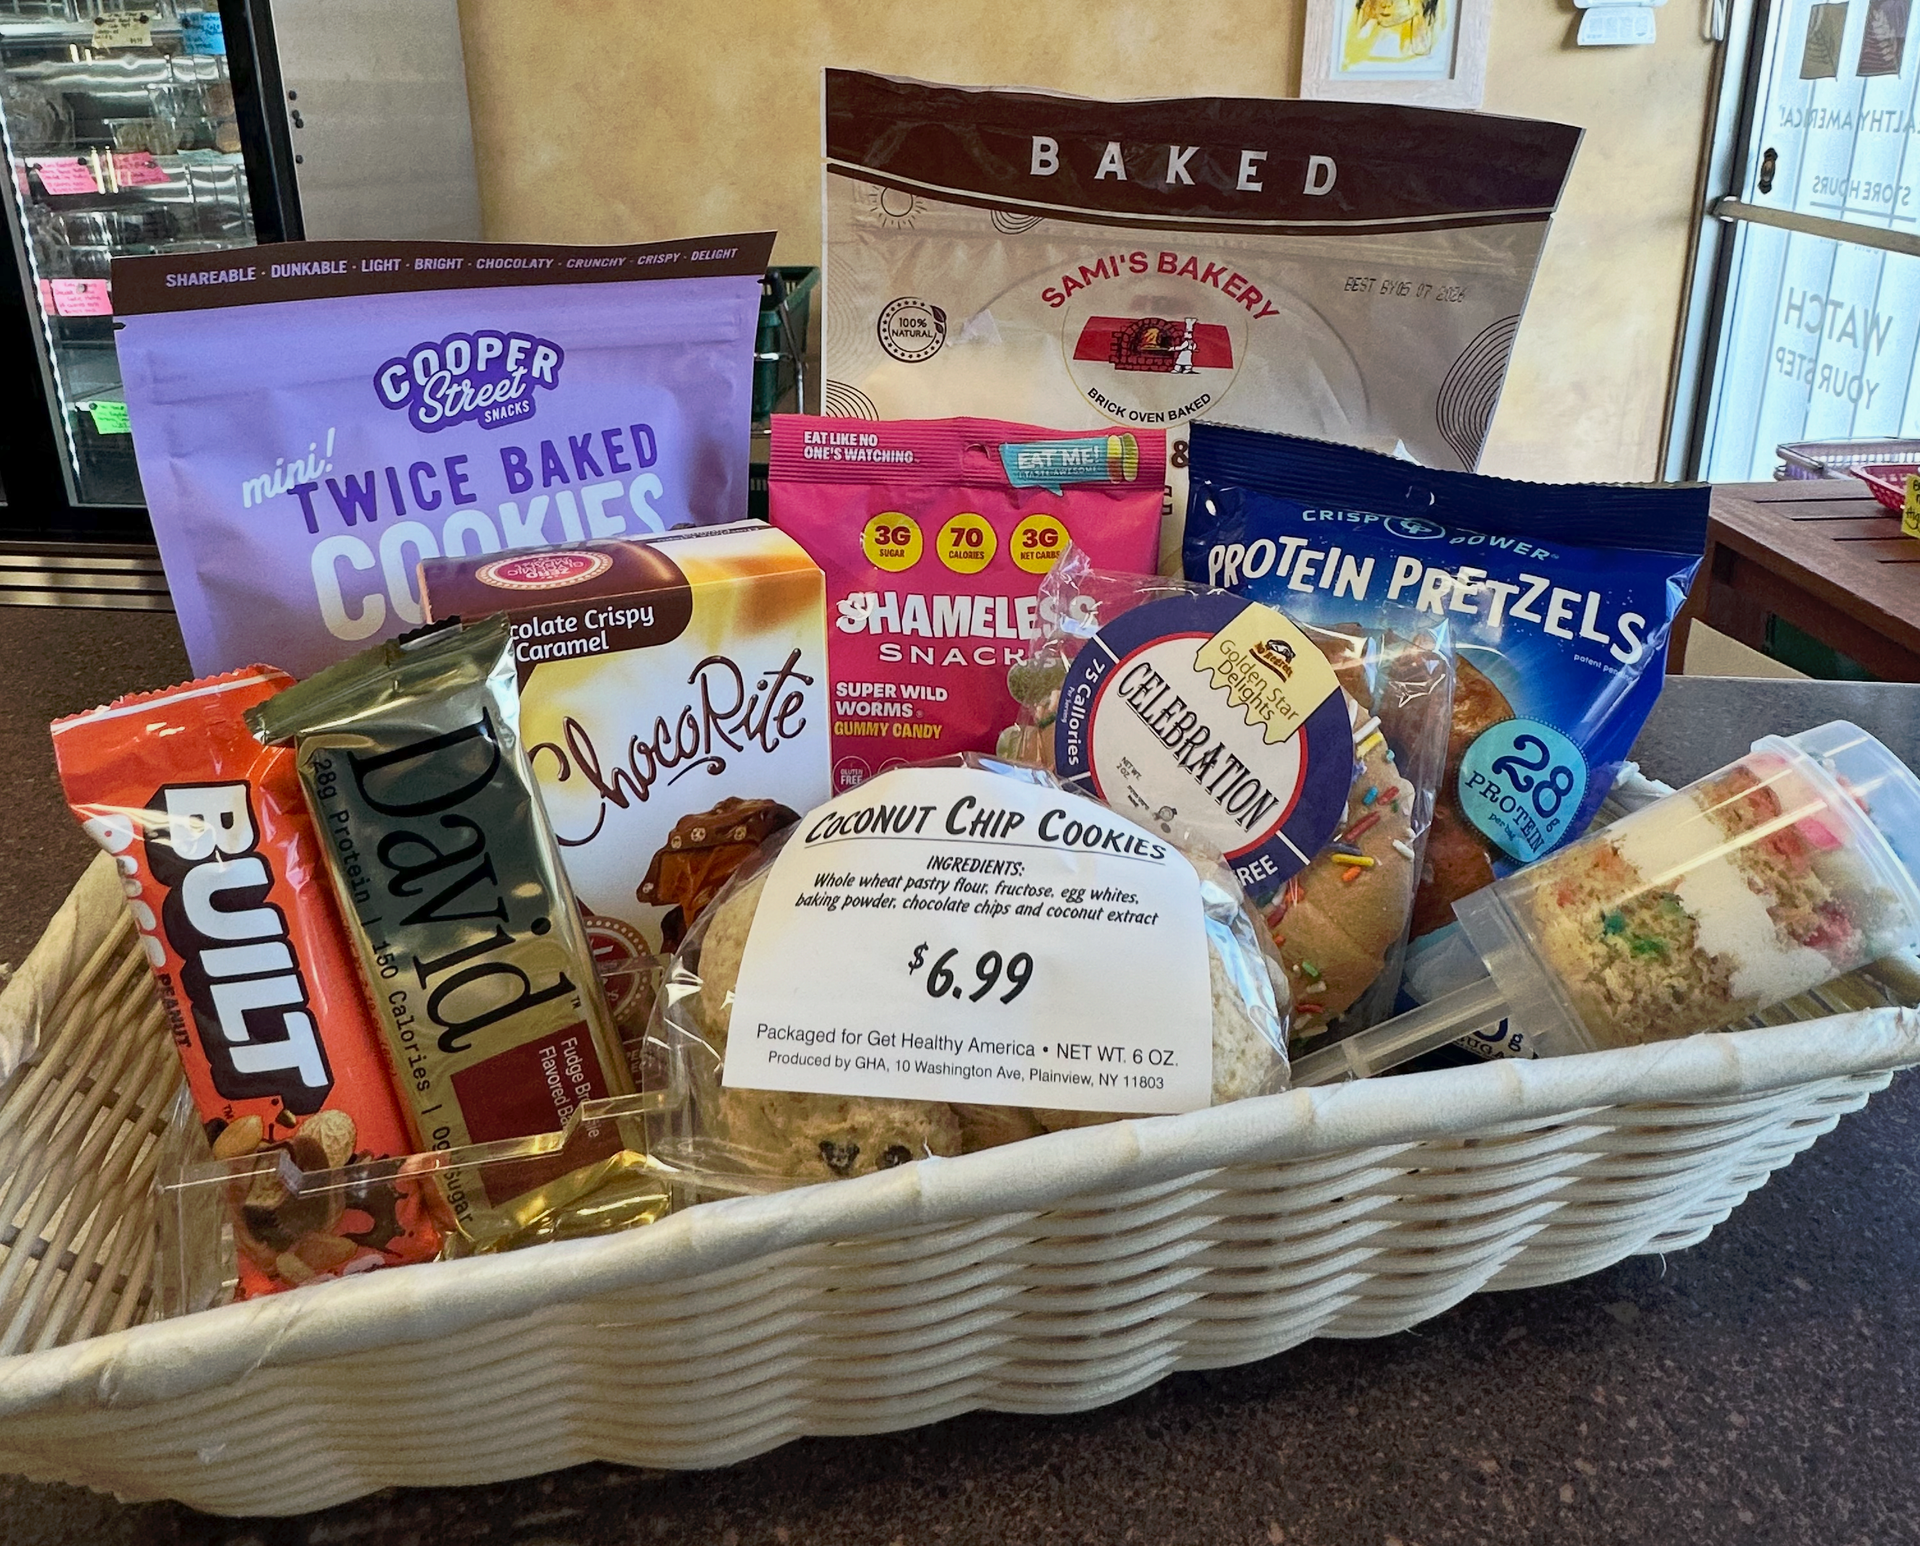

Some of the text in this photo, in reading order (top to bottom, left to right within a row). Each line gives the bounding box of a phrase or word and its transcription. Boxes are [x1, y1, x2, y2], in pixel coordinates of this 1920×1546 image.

[1030, 135, 1337, 196] BAKED
[166, 249, 738, 287] SHAREABLE DUNKABLE LIGHT BRIGHT CHOCOLATY CRUNCHY CRISPY DELIGHT
[1041, 251, 1280, 320] SAMI'S BAKERY
[1344, 277, 1377, 292] BEST
[892, 329, 933, 338] NATURAL
[899, 317, 927, 328] 100%
[381, 337, 557, 403] COOPER
[418, 366, 528, 424] Street
[484, 400, 530, 423] SNACKS
[1087, 387, 1212, 423] BRICK OVEN BAKED
[804, 431, 878, 447] EAT LIKE NO
[804, 446, 914, 463] ONE'S WATCHING
[1171, 440, 1189, 468] &
[242, 428, 336, 508] mini!
[1018, 446, 1099, 469] EAT ME!
[287, 423, 658, 534] TWICE BAKED
[874, 526, 1059, 548] 3G 70 3G
[1302, 510, 1380, 524] CRISP
[1449, 536, 1551, 560] POWER
[879, 549, 905, 558] SUGAR
[949, 550, 985, 560] CALORIES
[1020, 550, 1061, 560] NET CARBS
[584, 606, 654, 630] Crispy
[1209, 536, 1646, 664] PROTEIN PRETZELS
[516, 630, 609, 662] Caramel
[1574, 654, 1602, 668] patent
[1085, 658, 1106, 683] 75
[1219, 639, 1299, 720] Golden Star
[836, 682, 948, 702] SUPER WILD
[1217, 659, 1275, 721] Delights
[836, 701, 913, 718] WORMS
[834, 720, 943, 740] GUMMY CANDY
[1117, 661, 1279, 833] CELEBRATION
[841, 775, 862, 785] FREE
[805, 795, 1167, 860] COCONUT CHIP COOKIES
[1465, 771, 1545, 853] PROTEIN
[347, 706, 577, 1054] David
[926, 855, 1025, 877] INGREDIENTS:
[814, 872, 1139, 905] Whole wheat pastry flour, fructose, egg whites,
[313, 759, 337, 801] 28g
[329, 809, 371, 904] Protein
[372, 942, 399, 980] 150
[388, 990, 430, 1092] Calories
[795, 892, 1159, 926] baking powder, chocolate chips and coconut extract
[160, 782, 331, 1090] BUILT
[907, 941, 1034, 1005] $6.99
[157, 973, 192, 1048] PEANUT
[561, 1037, 584, 1083] Fudge
[757, 1023, 1178, 1066] Packaged for Get Healthy America NET WT. 6 OZ.
[538, 1045, 567, 1105] Flavored
[768, 1050, 1164, 1089] Produced by GHA, 10 Washington Ave, Plainview, NY 11803
